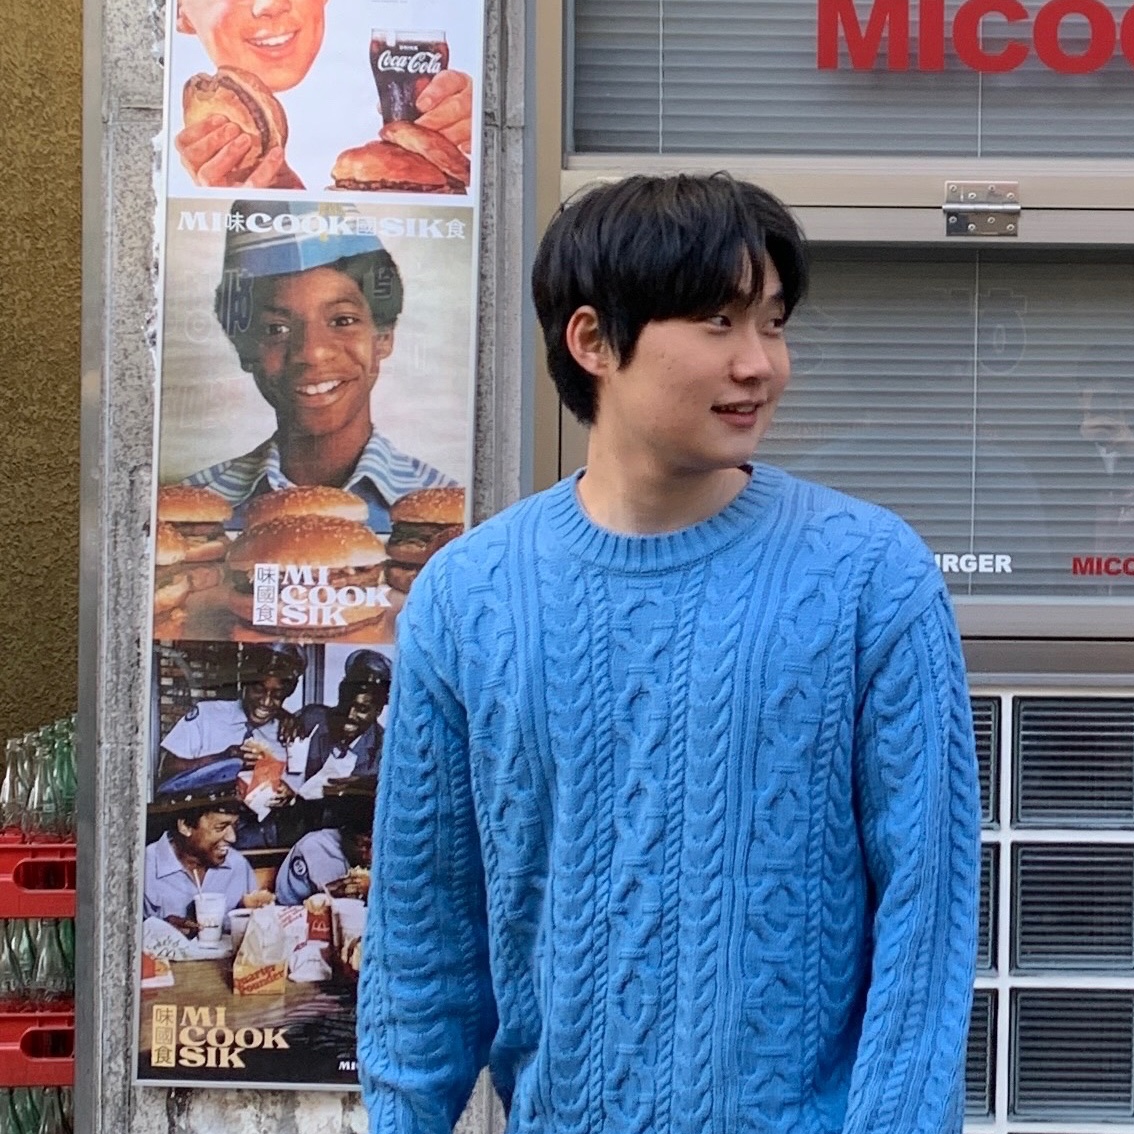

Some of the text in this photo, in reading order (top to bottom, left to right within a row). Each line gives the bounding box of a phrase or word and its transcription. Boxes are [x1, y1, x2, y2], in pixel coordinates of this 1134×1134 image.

[377, 50, 442, 74] Coca-Cola
[281, 565, 330, 586] MI
[256, 567, 277, 623] 味國食
[280, 584, 392, 607] COOK
[280, 604, 348, 626] SIK
[180, 1006, 226, 1027] MI
[155, 1007, 174, 1065] 味國食
[178, 1026, 289, 1049] COOK
[178, 1047, 245, 1068] SIK
[338, 1061, 358, 1070] MI
